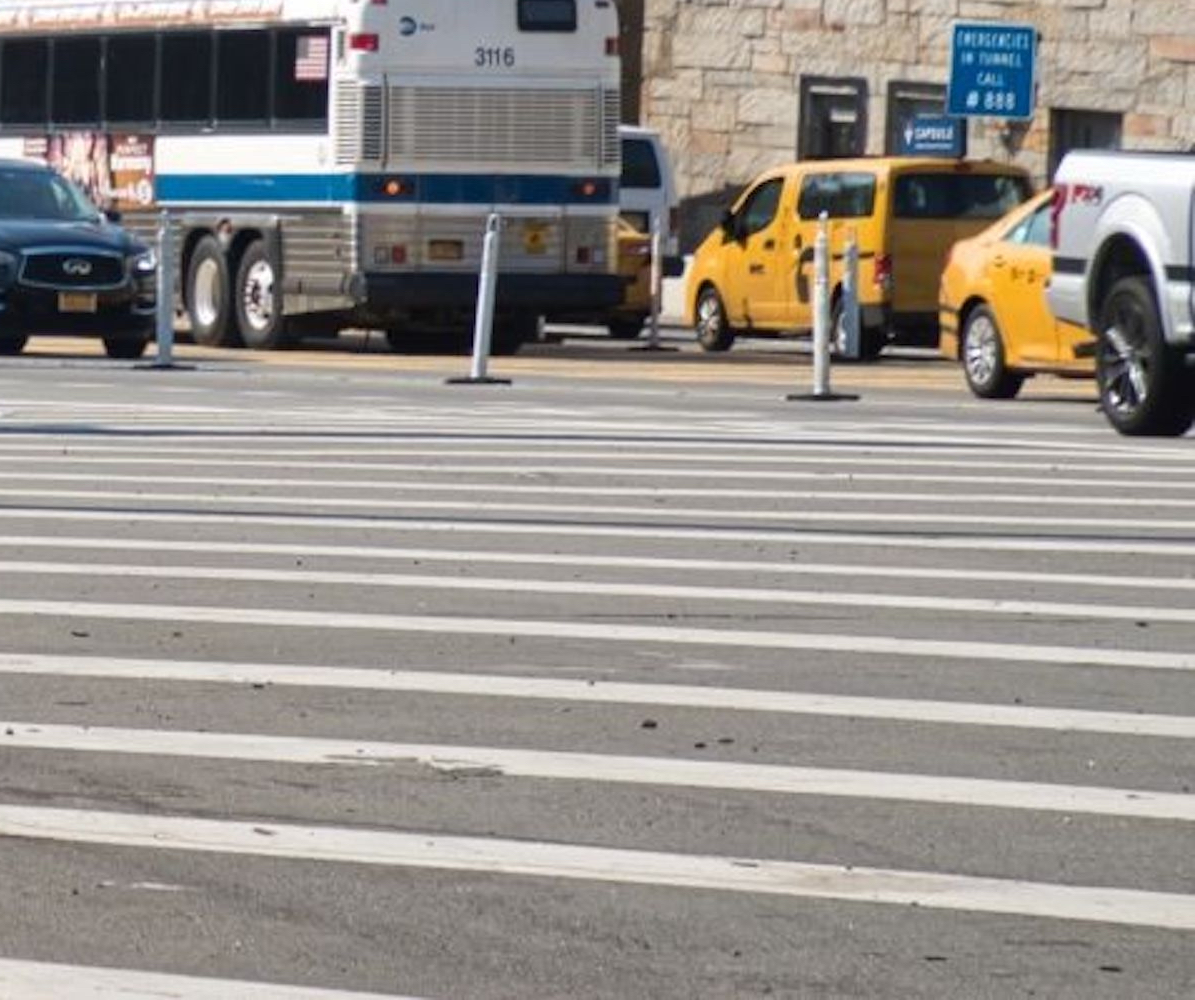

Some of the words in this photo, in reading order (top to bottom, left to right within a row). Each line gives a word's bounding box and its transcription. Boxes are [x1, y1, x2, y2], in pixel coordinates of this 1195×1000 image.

[475, 47, 515, 67] 3116
[976, 72, 1006, 86] CALL
[984, 91, 1016, 111] 888
